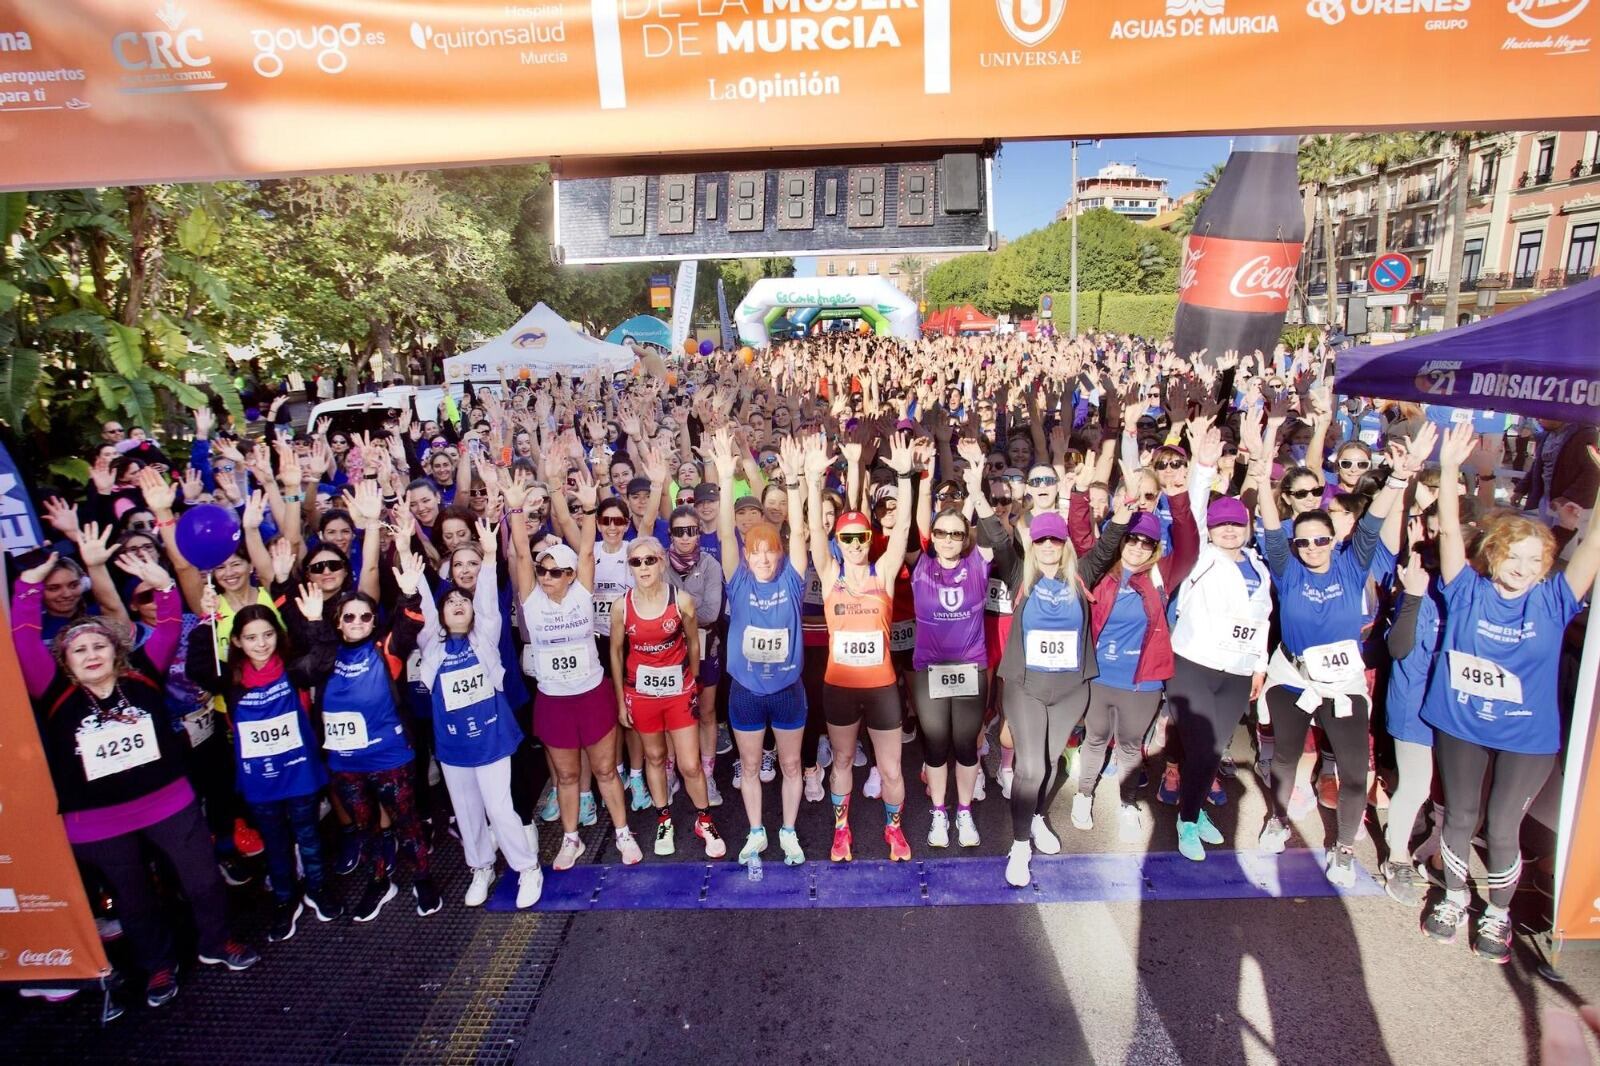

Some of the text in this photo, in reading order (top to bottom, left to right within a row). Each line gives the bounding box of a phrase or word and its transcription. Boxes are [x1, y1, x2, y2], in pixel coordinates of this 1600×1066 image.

[1110, 15, 1279, 39] AGUAS DE MURCIA
[1424, 19, 1469, 31] GRUPO
[642, 15, 902, 57] DE MURCIA
[1554, 34, 1592, 52] Hogar
[112, 28, 211, 70] CRC
[520, 50, 568, 64] Murcia
[979, 50, 1082, 67] UNIVERSAE
[709, 71, 840, 102] LaOpinión
[33, 88, 46, 102] ti
[471, 364, 487, 373] FM
[1428, 369, 1457, 396] 21
[890, 627, 913, 641] 330
[1232, 625, 1257, 641] 587
[751, 637, 782, 651] 1015
[842, 641, 875, 654] 1803
[1040, 641, 1064, 654] 603
[552, 656, 577, 670] 839
[1321, 652, 1349, 669] 440
[452, 673, 484, 694] 4347
[643, 675, 676, 688] 3545
[941, 673, 966, 685] 696
[1461, 666, 1505, 688] 4981
[250, 724, 290, 743] 3094
[326, 722, 356, 736] 2479
[96, 734, 144, 759] 4236
